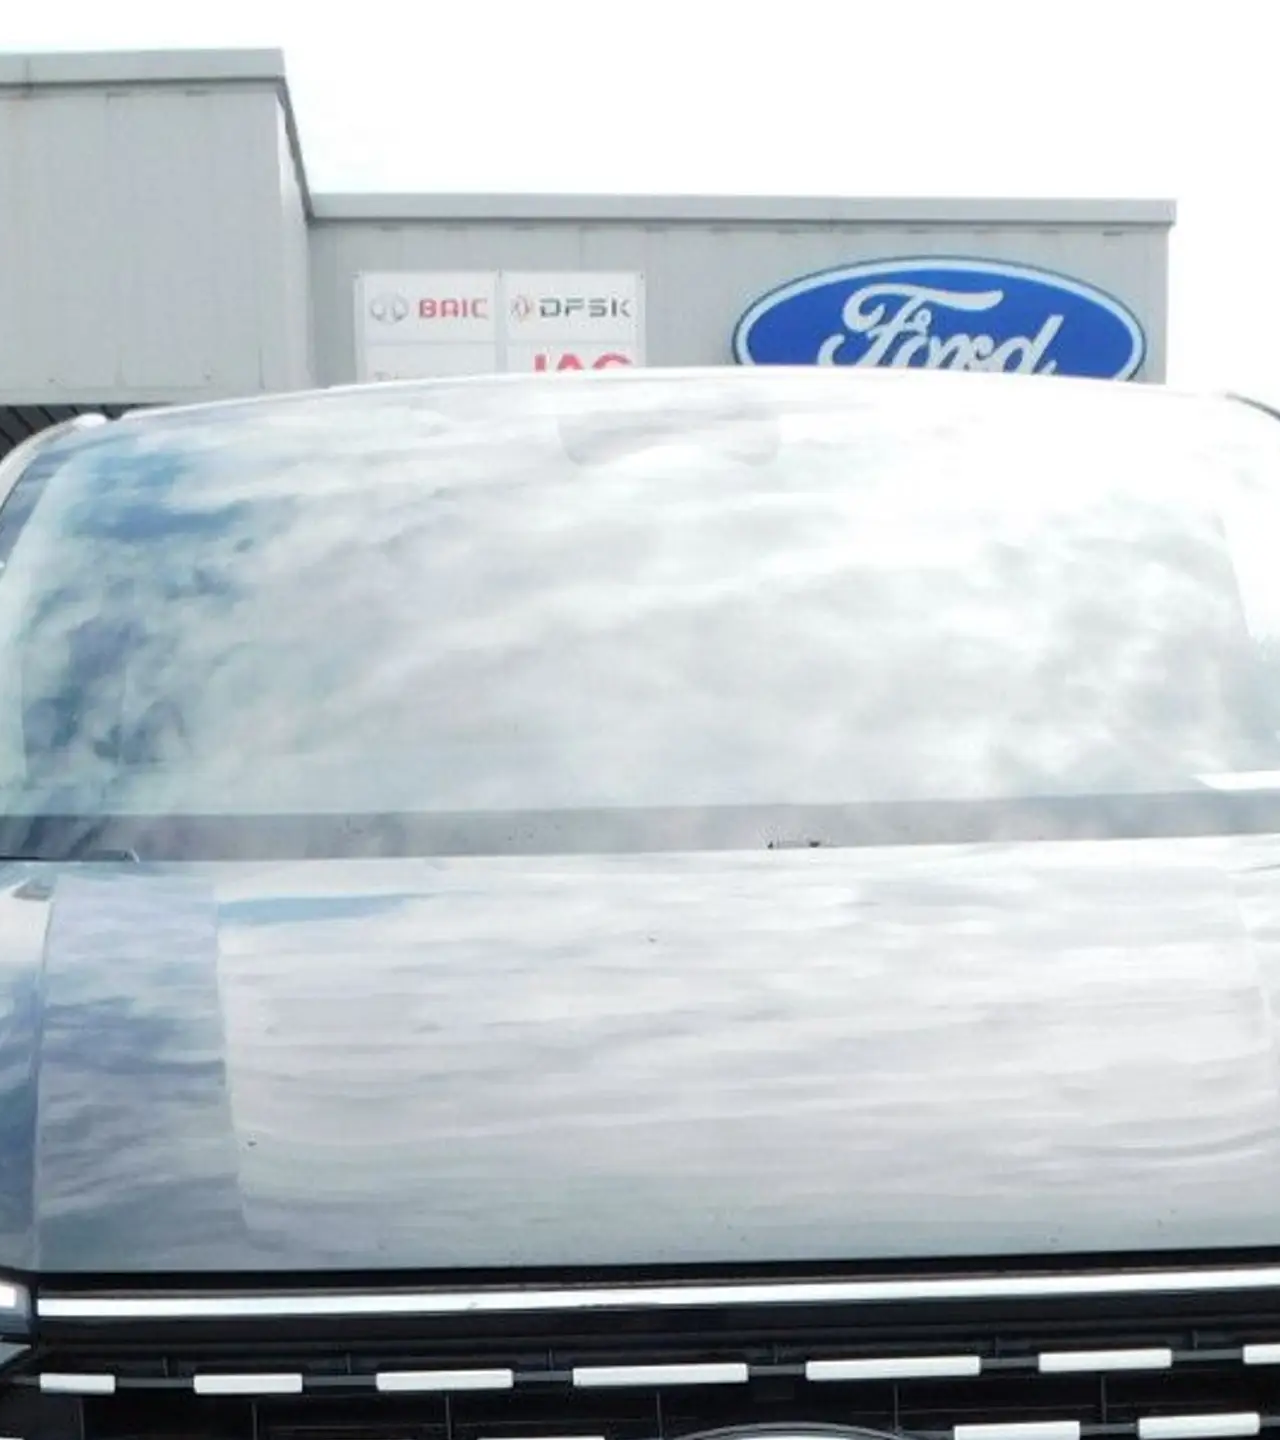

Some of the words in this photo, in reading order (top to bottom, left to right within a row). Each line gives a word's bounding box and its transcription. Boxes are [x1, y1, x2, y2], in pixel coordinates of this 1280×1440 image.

[418, 298, 489, 320] BAIC
[539, 297, 632, 319] DFSK
[816, 283, 1065, 375] Ford
